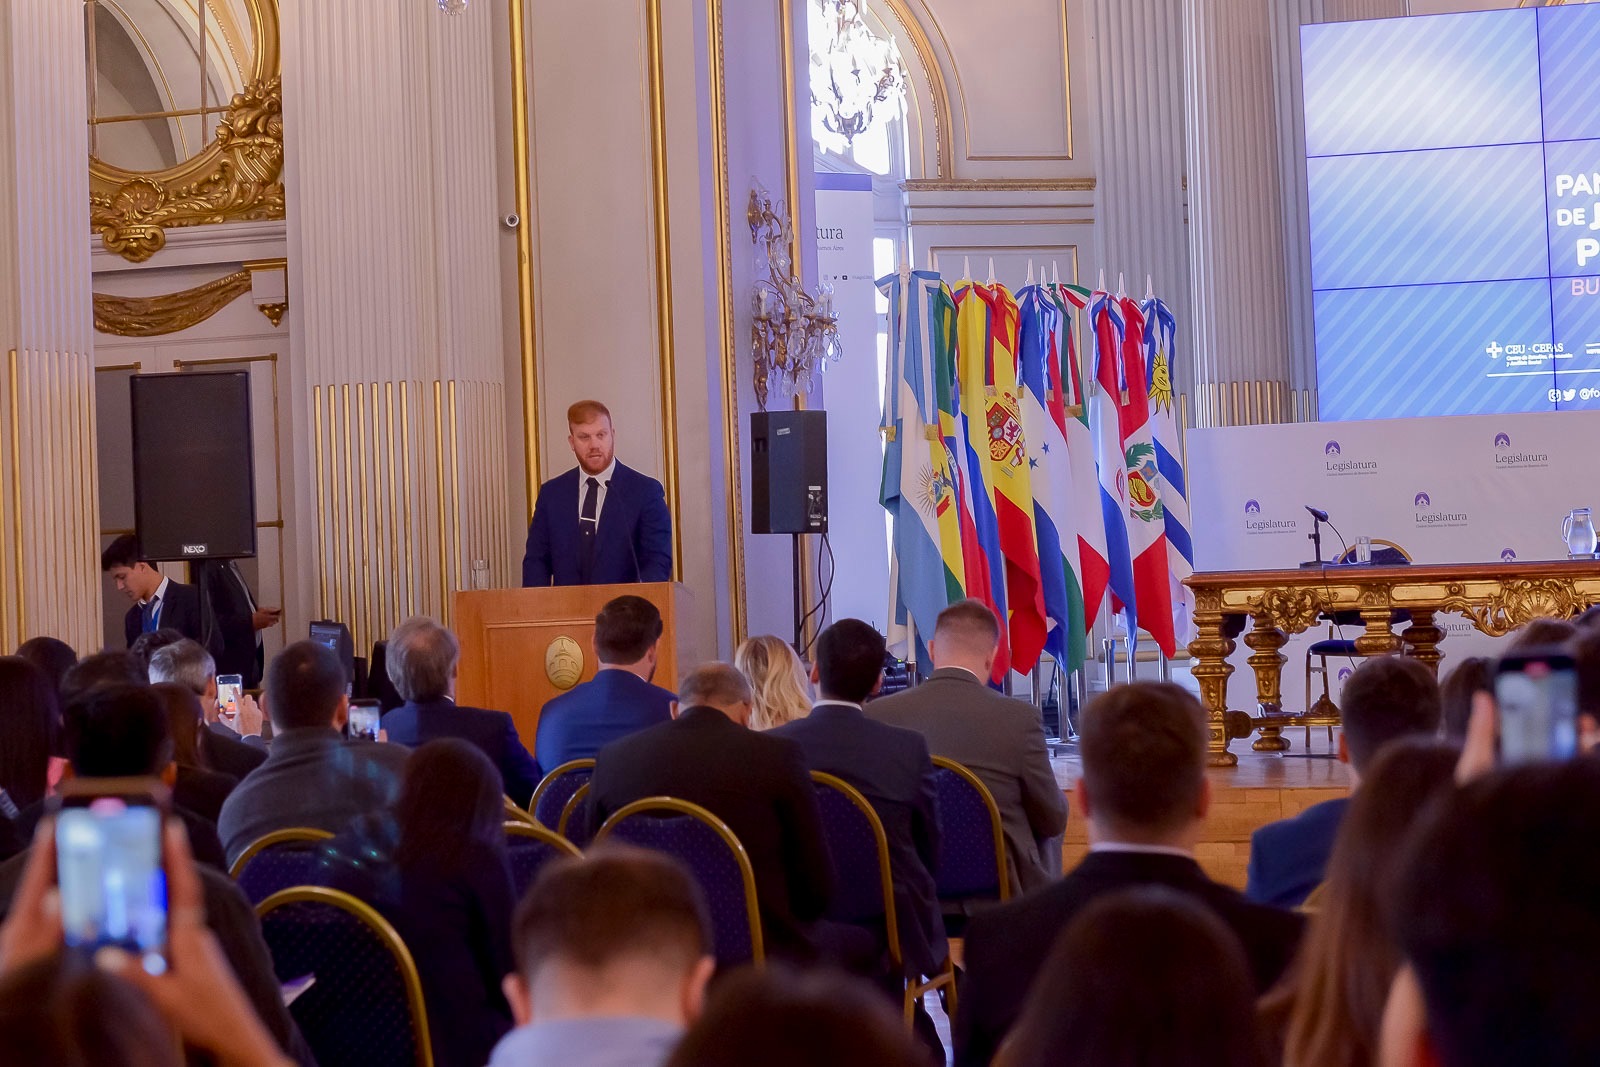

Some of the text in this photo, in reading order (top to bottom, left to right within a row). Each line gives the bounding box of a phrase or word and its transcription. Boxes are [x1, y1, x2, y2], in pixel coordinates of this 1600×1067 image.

[1556, 207, 1585, 226] DE
[1576, 238, 1600, 267] P
[1571, 277, 1600, 296] BU
[1505, 344, 1526, 354] CEU
[1495, 452, 1548, 464] Legislatura
[1326, 460, 1377, 472] Legislatura
[1415, 512, 1468, 524] Legislatura
[1246, 519, 1297, 531] Legislatura
[183, 545, 205, 554] NEXO
